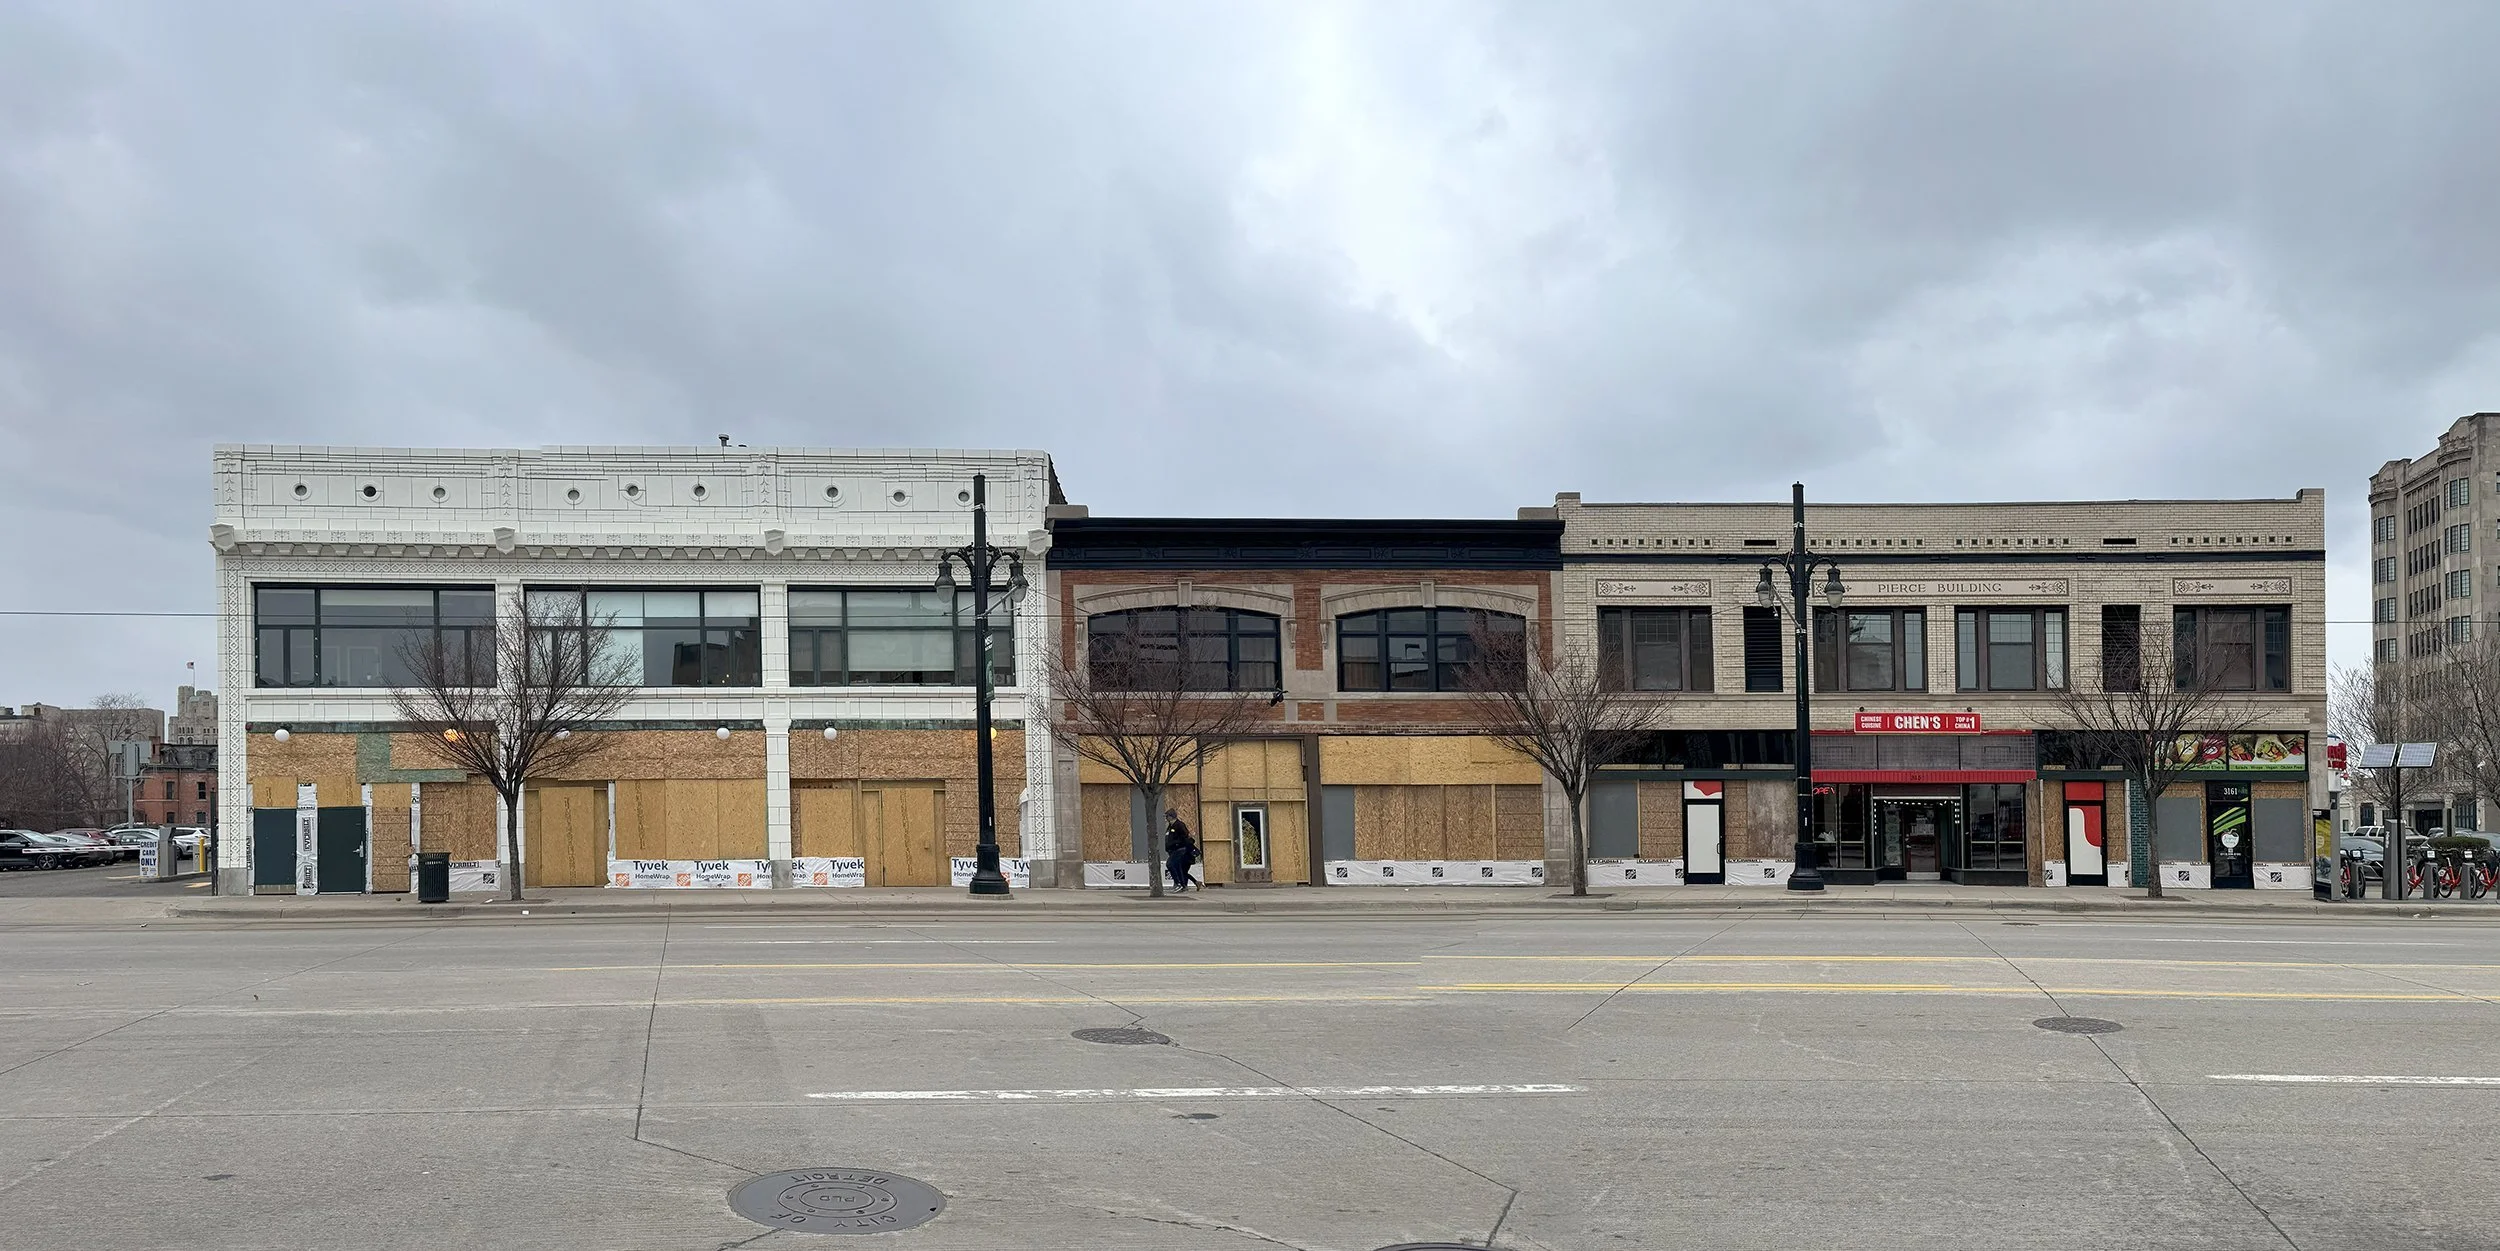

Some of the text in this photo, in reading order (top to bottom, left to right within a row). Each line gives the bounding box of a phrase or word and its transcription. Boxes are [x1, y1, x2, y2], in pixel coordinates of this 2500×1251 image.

[1878, 583, 2002, 593] PIERCE BUILDING
[1894, 715, 1941, 729] CHEN'S
[2223, 787, 2238, 795] 3161
[140, 858, 157, 866] ONLY
[633, 861, 668, 873] Tyvek
[694, 861, 729, 873] Tyvek
[830, 859, 864, 872] Tyvek
[952, 858, 978, 871] Tyve
[791, 1172, 889, 1186] DETROIT
[770, 1212, 897, 1228] CITY OF
